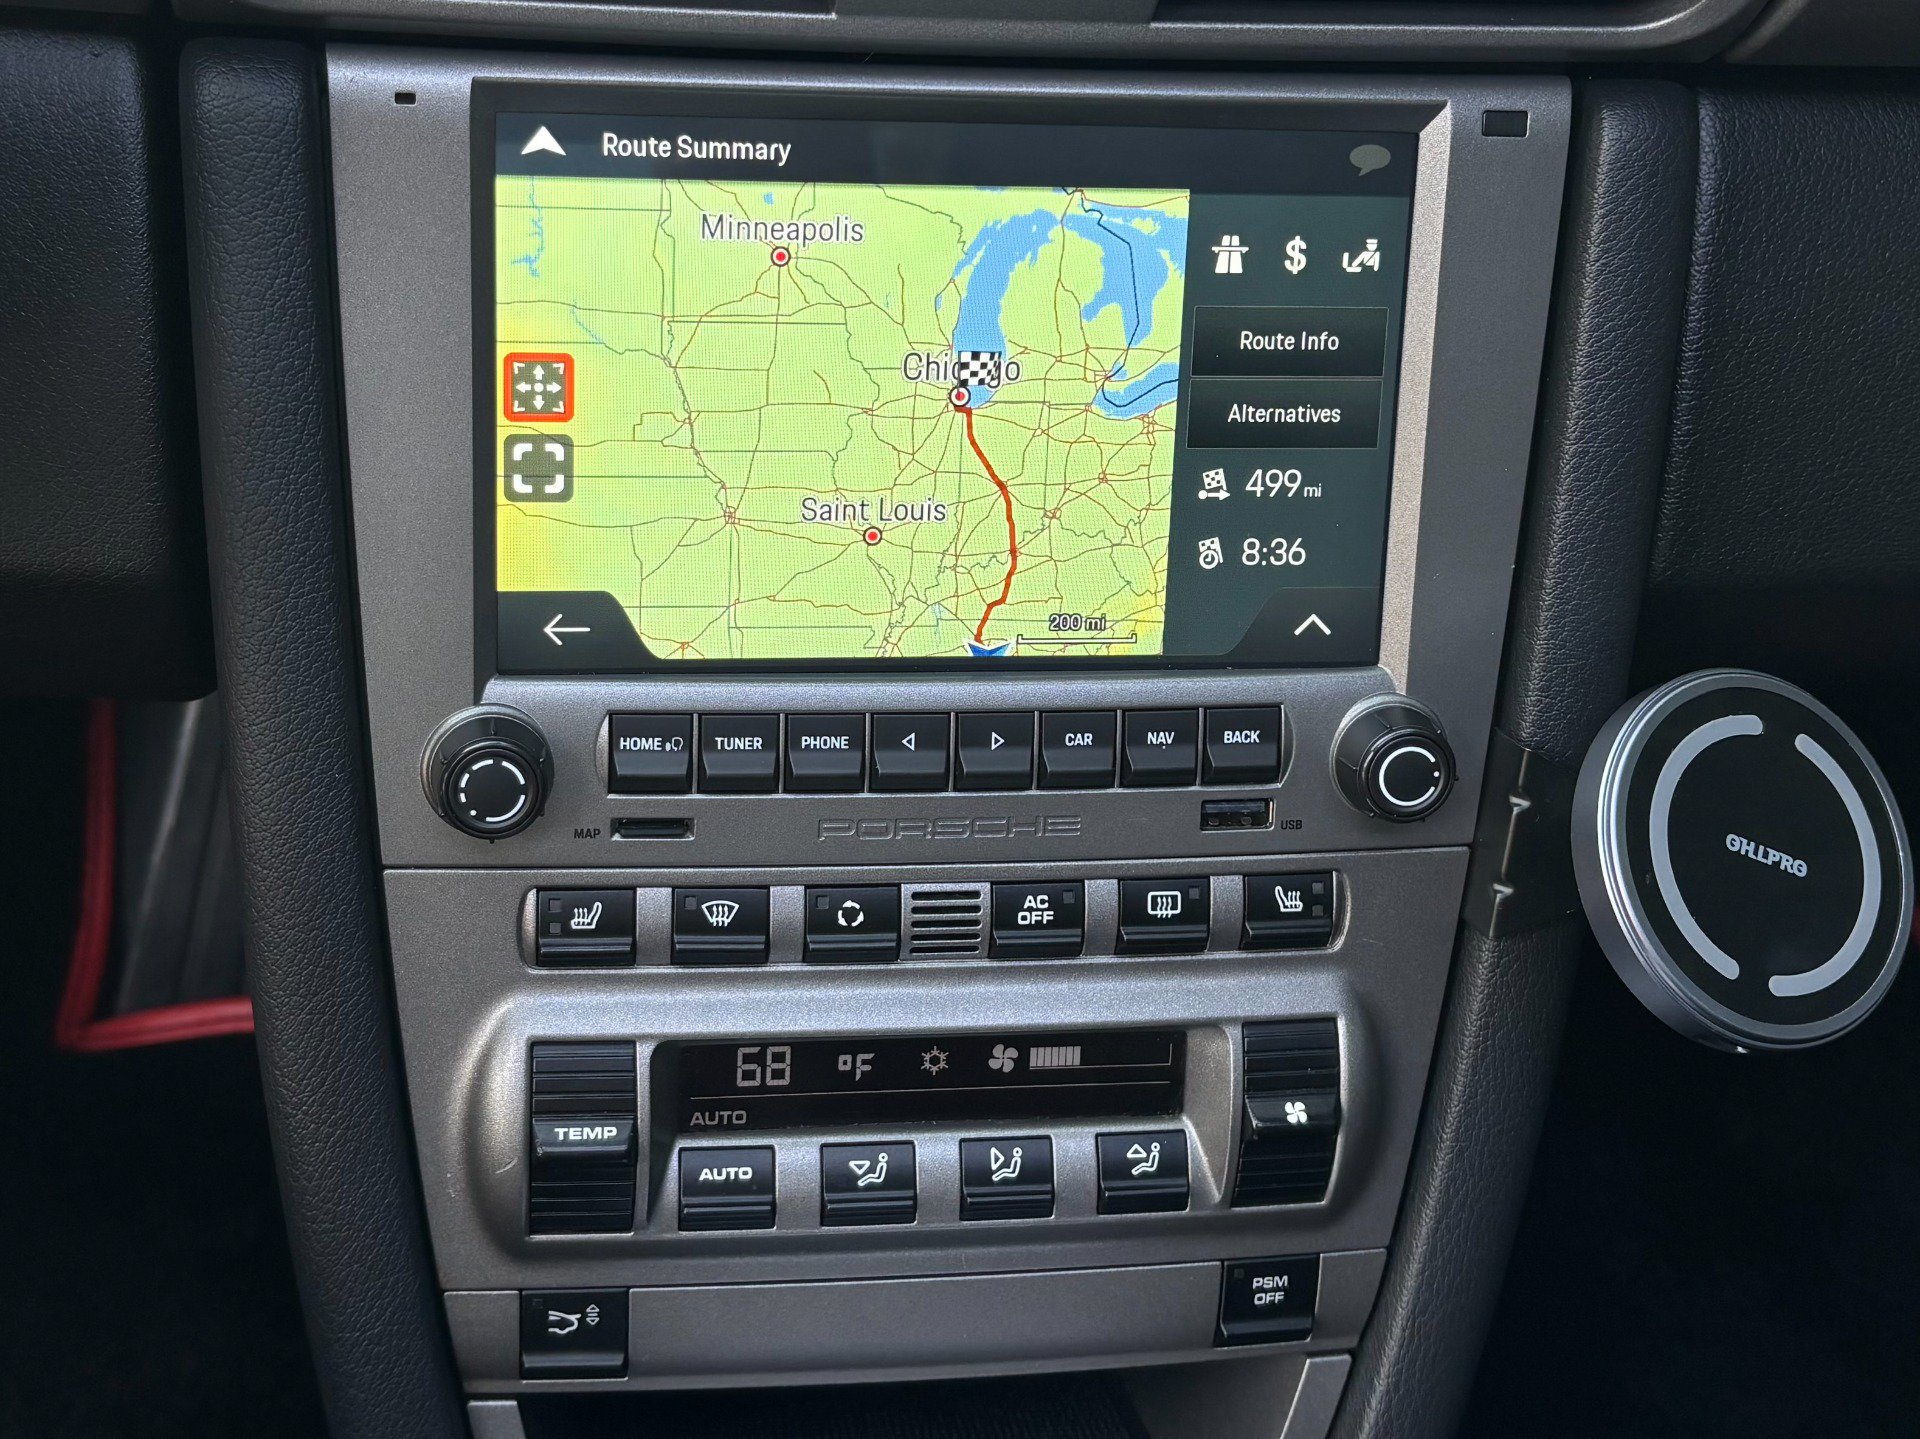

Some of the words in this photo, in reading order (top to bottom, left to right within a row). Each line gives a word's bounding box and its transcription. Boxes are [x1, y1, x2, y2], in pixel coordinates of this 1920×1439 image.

[602, 132, 672, 158] Route
[677, 135, 792, 166] Summary
[701, 213, 865, 248] Minneapolis
[1240, 330, 1296, 350] Route
[1301, 331, 1340, 350] Info
[1227, 403, 1342, 423] Alternatives
[1245, 468, 1302, 498] 499
[1303, 483, 1322, 498] mi
[801, 498, 870, 522] Saint
[879, 500, 947, 522] Louis
[1241, 537, 1306, 566] 8:36
[1049, 615, 1081, 632] 200
[1084, 615, 1106, 631] mi
[619, 737, 662, 751] HOME
[715, 737, 763, 750] TUNER
[801, 735, 849, 750] PHONE
[1065, 733, 1093, 747] CAR
[1147, 732, 1175, 745] NAV
[1223, 730, 1261, 744] BACK
[818, 815, 1082, 841] PORSCHE
[1280, 820, 1303, 831] USB
[573, 828, 601, 840] MAP
[1023, 895, 1049, 909] AC
[1017, 911, 1054, 925] OFF
[736, 1046, 792, 1087] 68
[690, 1110, 748, 1126] AUTO
[554, 1127, 618, 1140] TEMP
[699, 1167, 753, 1181] AUTO
[1252, 1275, 1288, 1289] PSM
[1254, 1292, 1284, 1305] OFF
